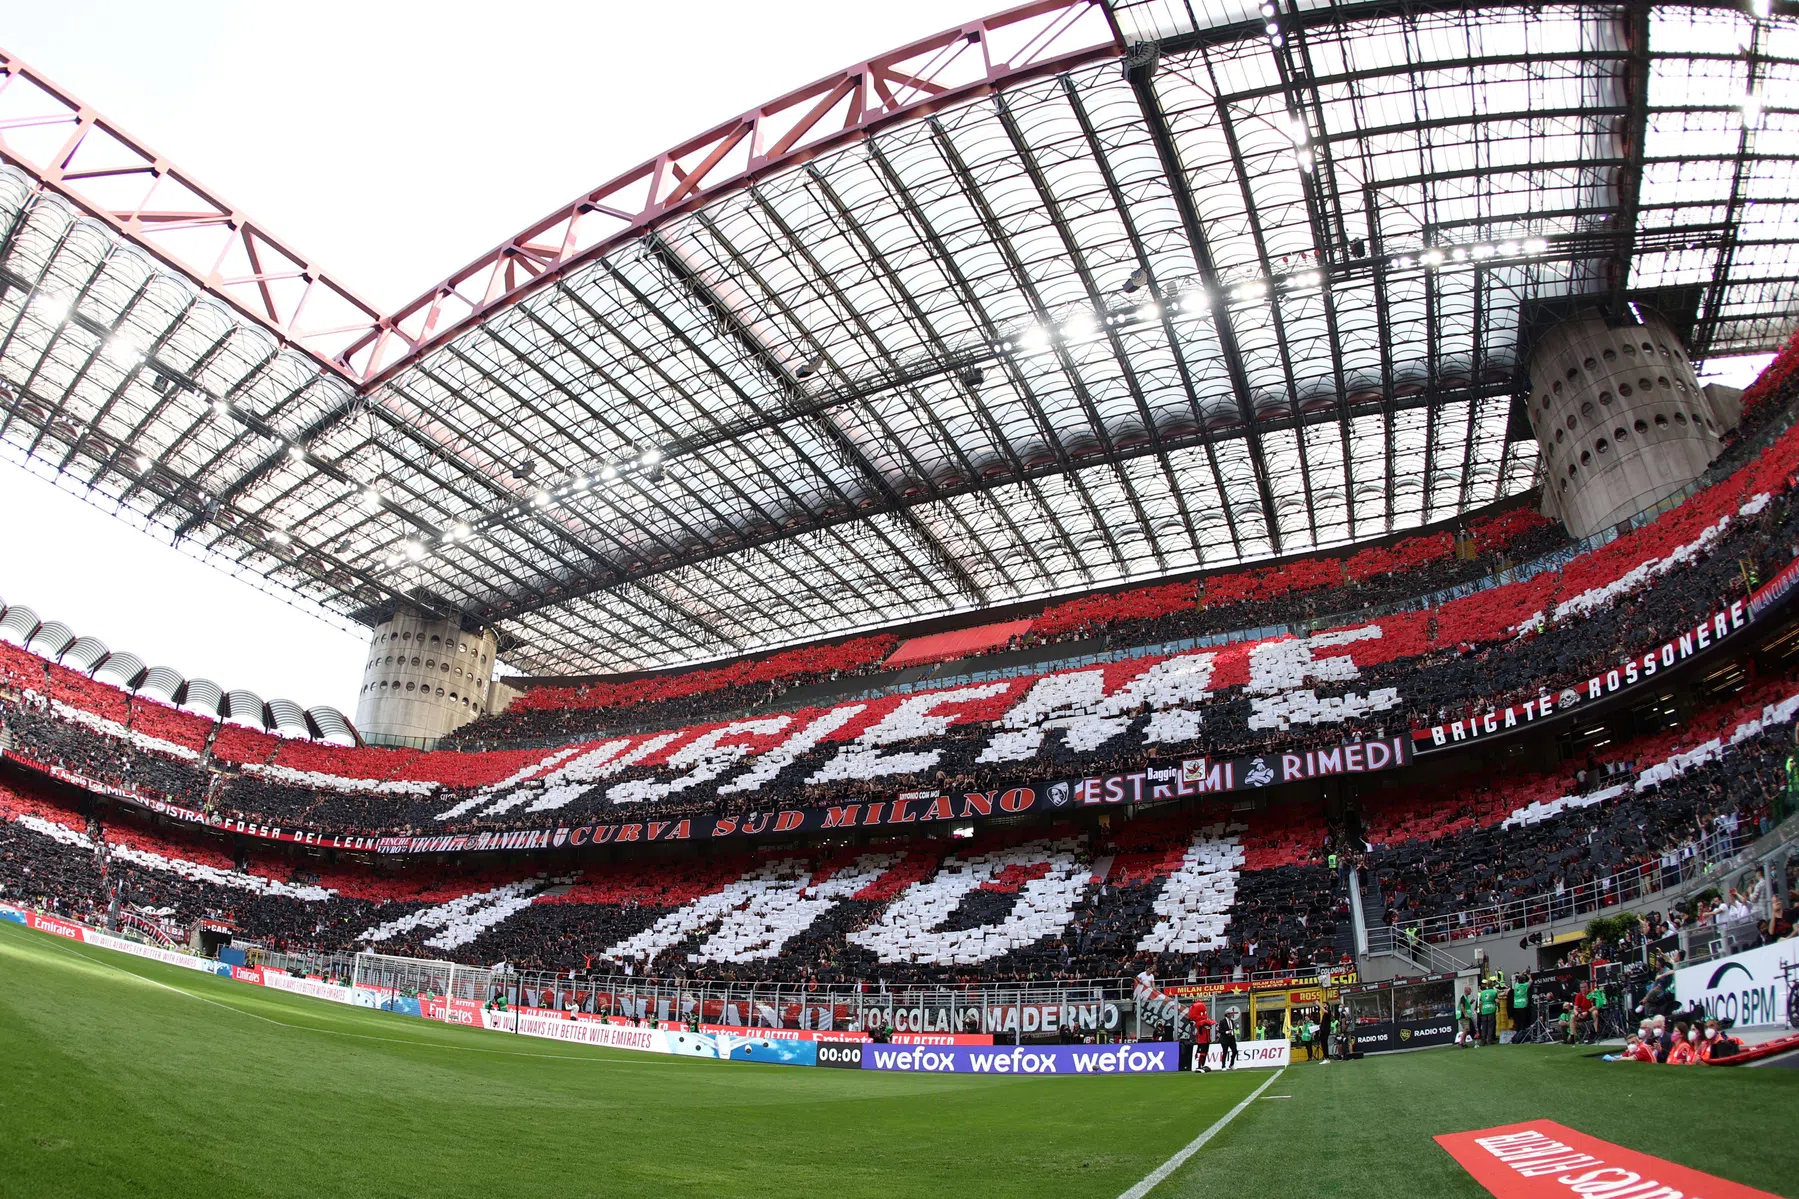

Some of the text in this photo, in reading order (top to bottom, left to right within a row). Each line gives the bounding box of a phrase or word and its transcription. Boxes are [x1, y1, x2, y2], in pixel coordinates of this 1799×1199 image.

[1431, 600, 1745, 746] BRIGATE ROSSONERE
[8, 751, 44, 772] VIADANA
[1282, 736, 1404, 782] RIMEDI
[60, 770, 87, 786] Angelo
[107, 785, 206, 824] MILAN ISTRA
[570, 787, 1036, 846] CURVA SUD MILANO
[224, 818, 381, 850] FOSSA DEI LEONI
[34, 917, 77, 939] Emirates
[159, 923, 184, 937] ALBA
[143, 947, 162, 959] BETTER
[236, 967, 260, 982] Emirates
[1204, 984, 1225, 992] CLUB
[429, 1003, 473, 1024] Emrates
[1742, 985, 1776, 1025] BPM
[857, 1007, 980, 1032] TOSCOLANO
[982, 1003, 1119, 1032] MADERNO
[489, 1014, 502, 1028] YOU
[519, 1020, 546, 1036] ALWAYS
[547, 1022, 559, 1037] FLY
[560, 1023, 587, 1040] BETTER
[589, 1027, 609, 1043] WITH
[612, 1030, 652, 1049] EMIRATES
[1357, 1034, 1388, 1043] RADIO 105
[1414, 1025, 1452, 1037] RADIO 105
[819, 1047, 861, 1063] 00:00
[873, 1045, 1165, 1073] wefox wefox wefox
